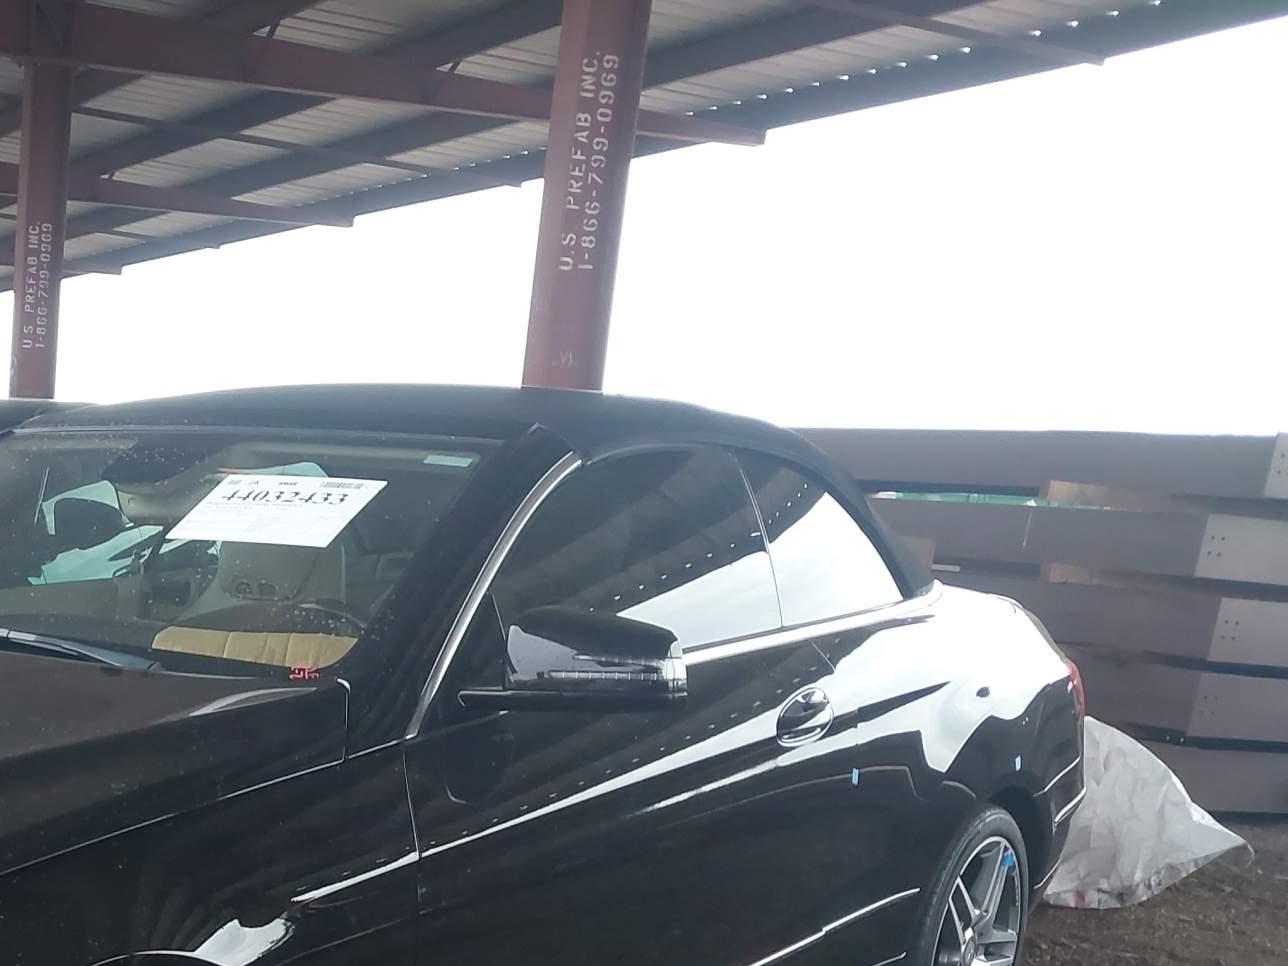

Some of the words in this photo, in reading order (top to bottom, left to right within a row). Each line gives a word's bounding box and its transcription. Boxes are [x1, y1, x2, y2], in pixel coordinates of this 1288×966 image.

[566, 111, 592, 210] PREFAB
[579, 51, 600, 98] INC.
[578, 54, 619, 270] 1-866-799-0969
[24, 256, 37, 313] PREFAB
[220, 488, 349, 506] 44032433
